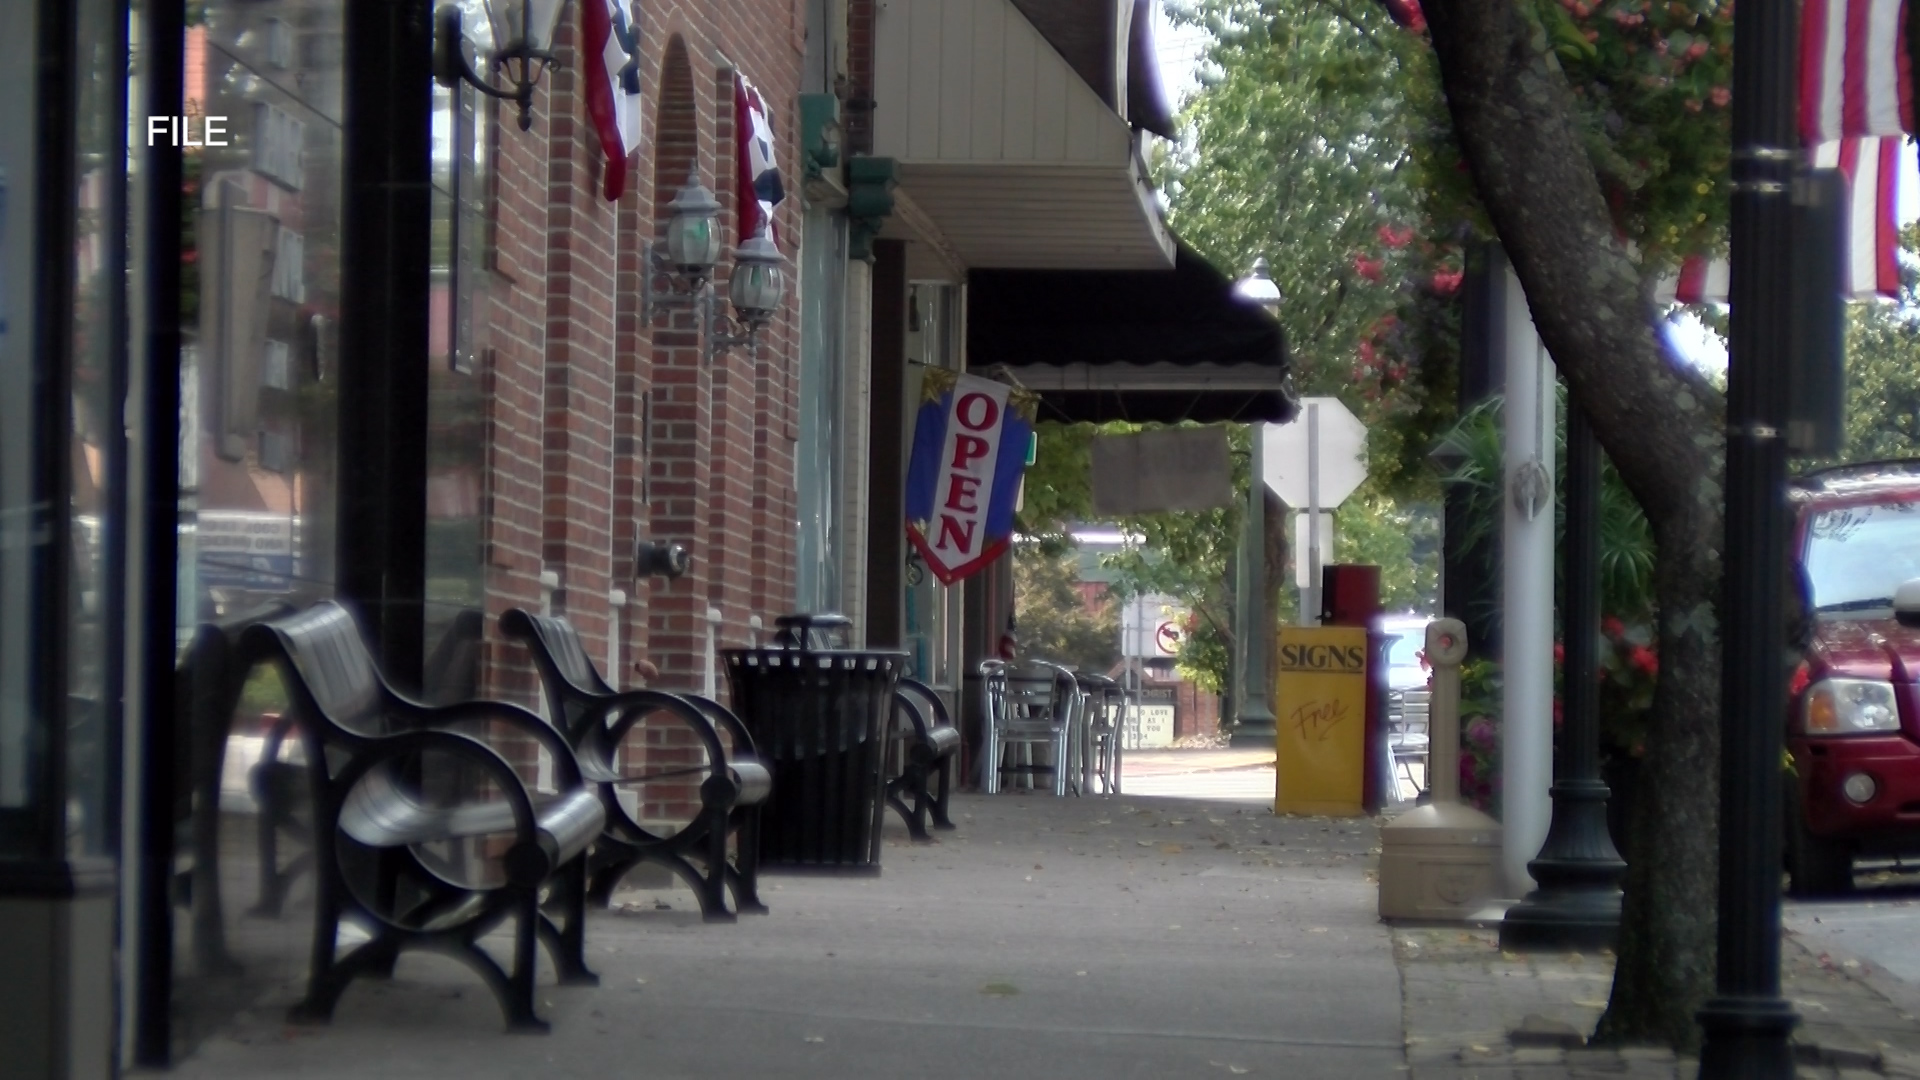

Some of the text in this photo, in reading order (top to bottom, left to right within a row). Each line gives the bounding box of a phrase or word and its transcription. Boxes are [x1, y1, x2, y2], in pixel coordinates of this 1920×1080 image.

[935, 392, 1000, 555] OPEN
[1280, 643, 1364, 669] SIGNS
[1290, 699, 1350, 740] Free
